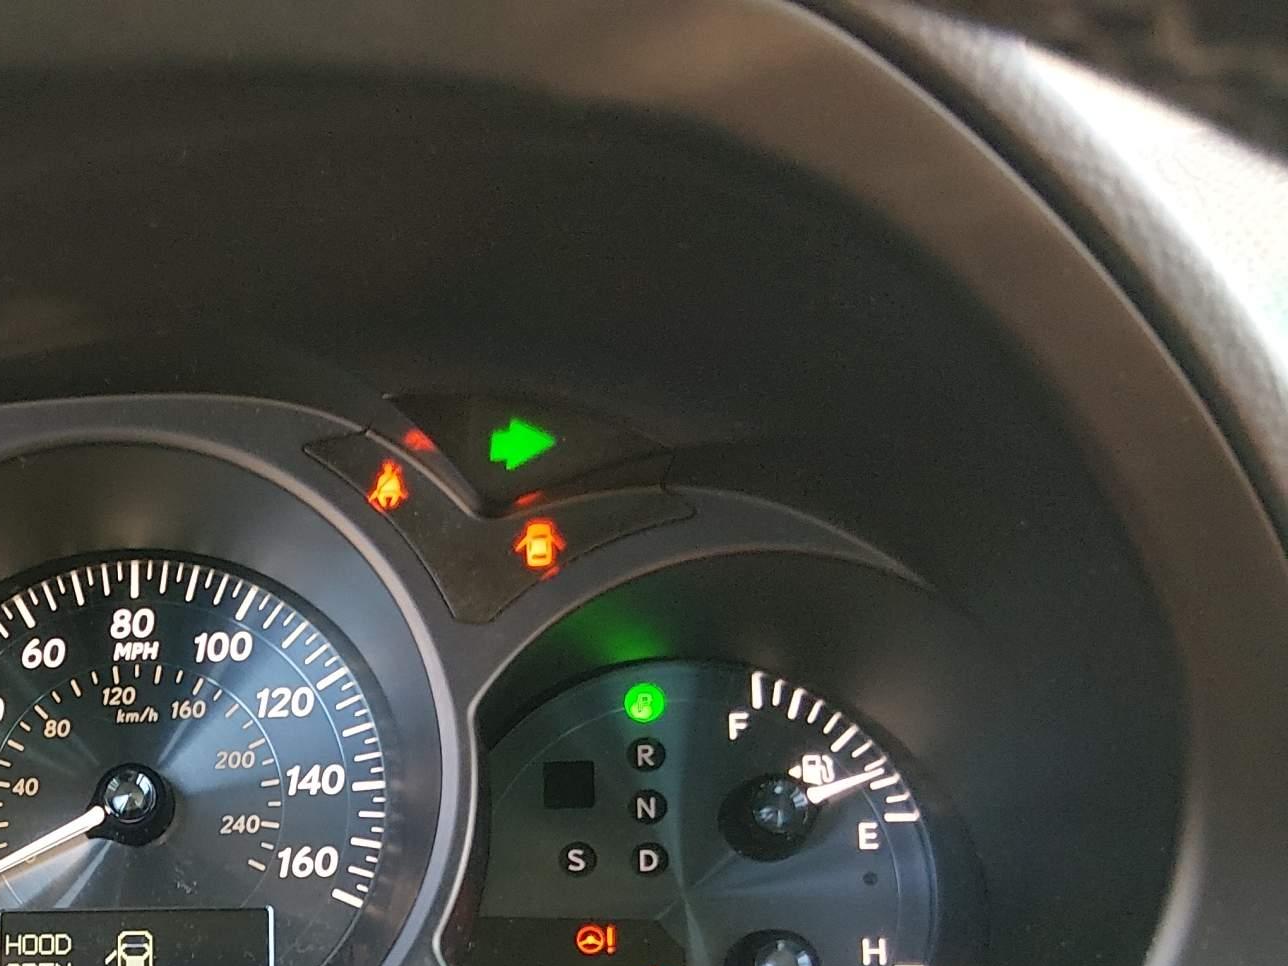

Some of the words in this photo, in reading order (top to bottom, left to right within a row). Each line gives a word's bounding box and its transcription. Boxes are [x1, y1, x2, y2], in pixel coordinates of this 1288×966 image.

[110, 608, 155, 640] 80
[21, 638, 66, 669] 60
[113, 640, 160, 662] MPH
[194, 631, 253, 662] 100
[102, 686, 136, 706] 120
[256, 687, 314, 719] 120
[116, 706, 159, 723] km/h
[172, 700, 206, 720] 160
[44, 719, 71, 738] 80
[728, 711, 749, 741] F
[214, 750, 256, 769] 200
[637, 744, 655, 767] R
[12, 777, 39, 796] 40
[286, 763, 346, 796] 140
[636, 796, 656, 819] N
[220, 814, 261, 834] 240
[858, 821, 880, 850] E
[277, 845, 339, 879] 160
[567, 849, 586, 872] S
[639, 849, 659, 872] D
[5, 933, 72, 956] HOOD
[861, 937, 888, 966] H
